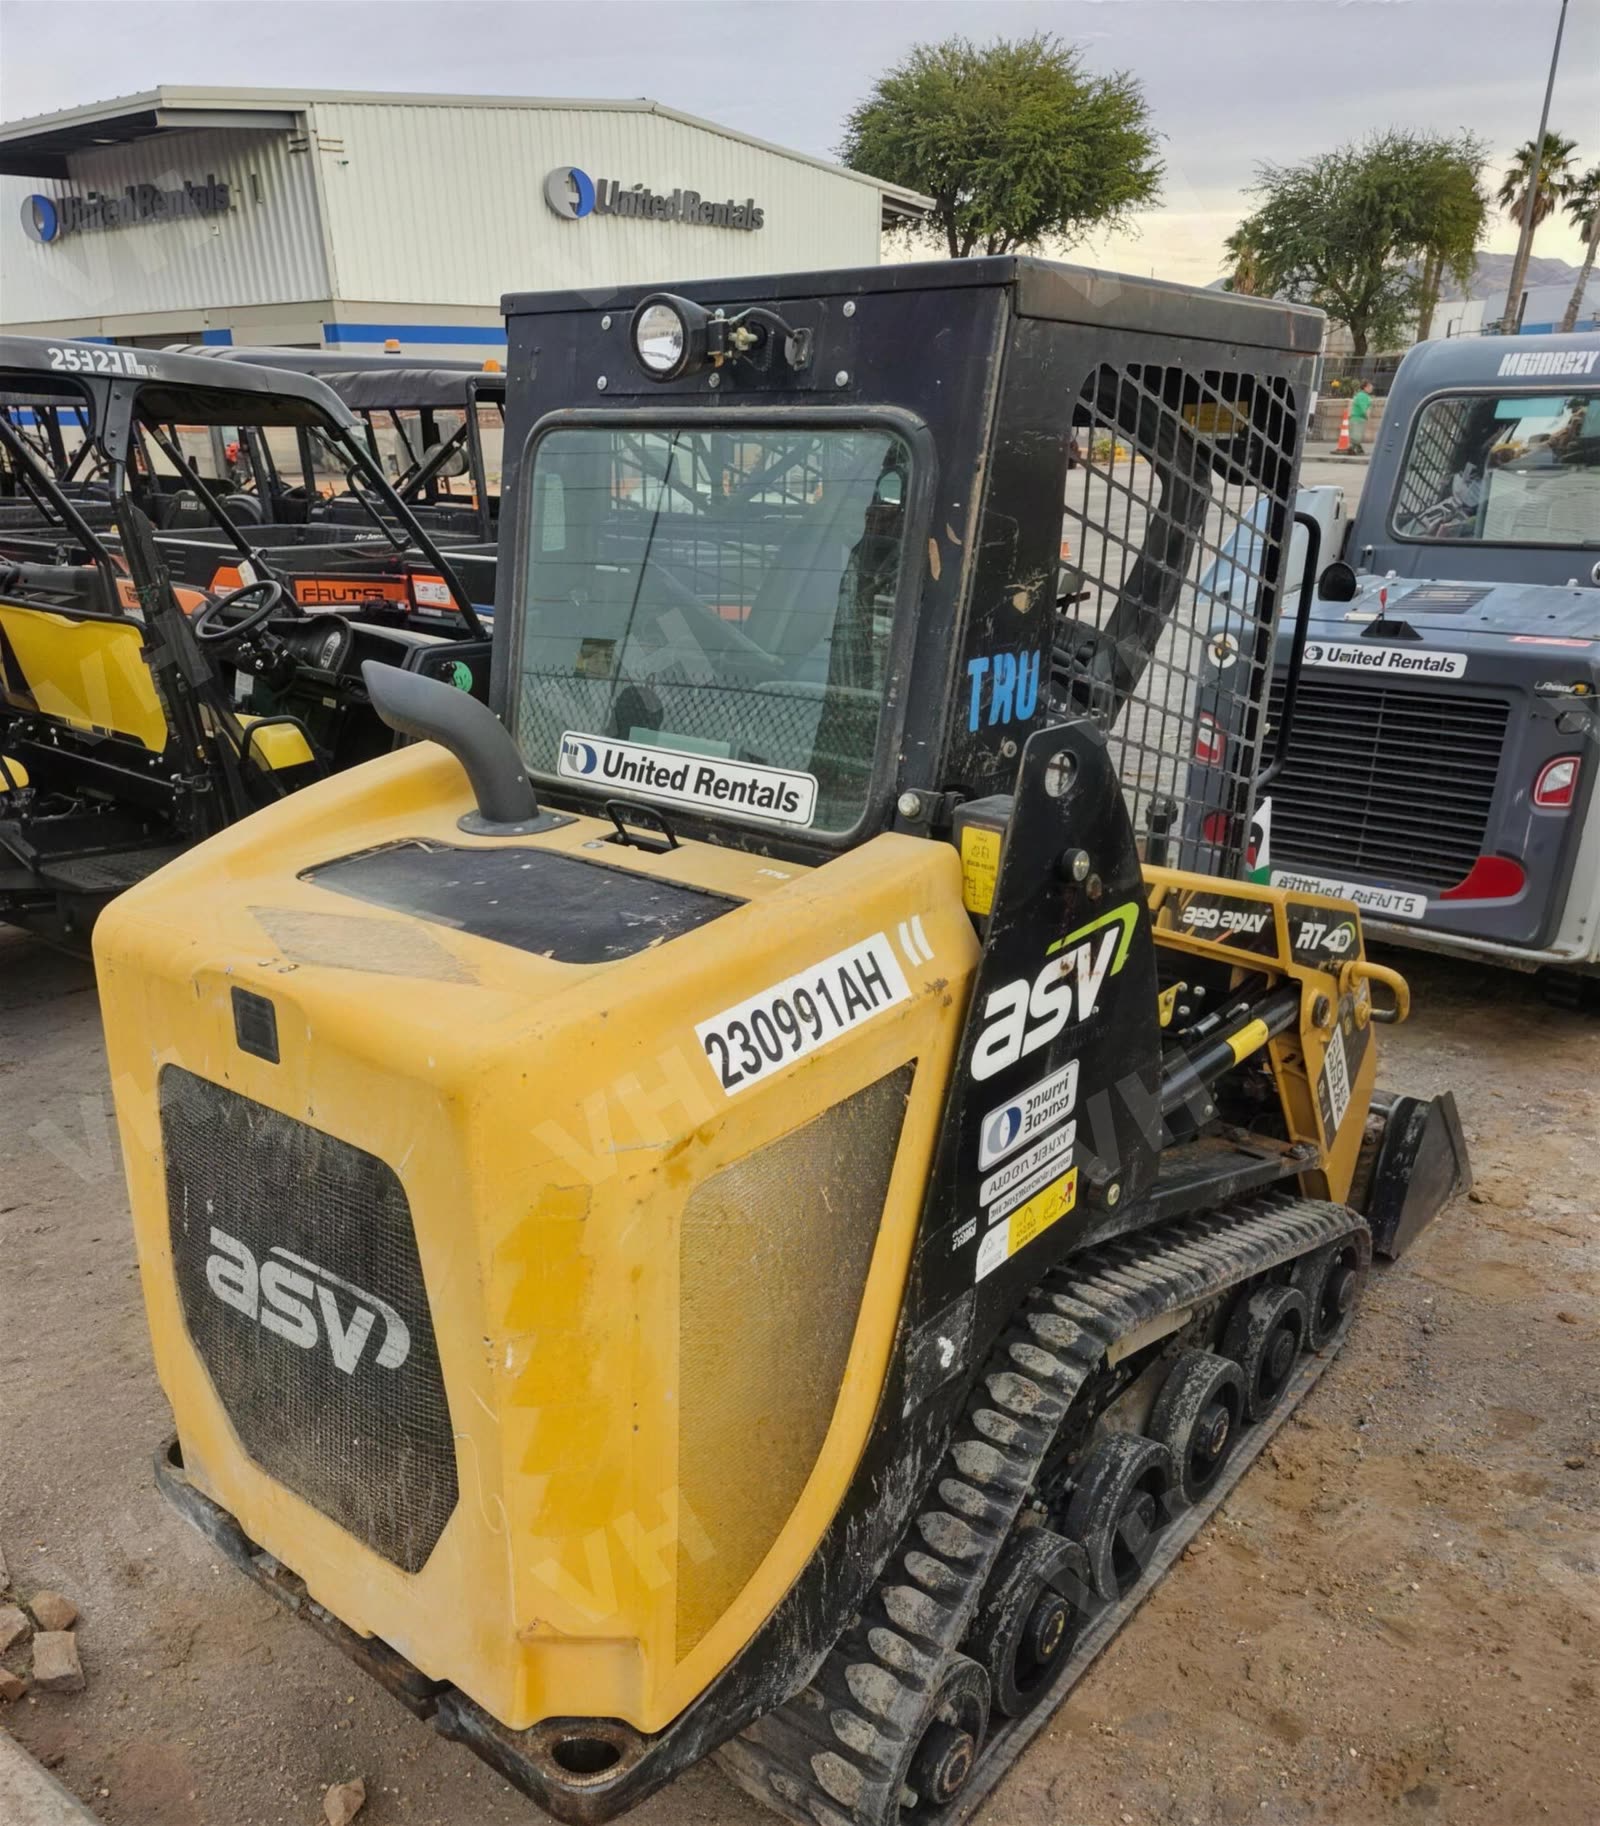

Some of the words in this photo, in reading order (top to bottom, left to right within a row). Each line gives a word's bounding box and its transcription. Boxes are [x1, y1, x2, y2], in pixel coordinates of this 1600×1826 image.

[595, 178, 681, 221] United
[682, 190, 764, 230] Rentals
[1326, 646, 1387, 667] United
[1388, 653, 1456, 673] Rentals
[602, 749, 690, 792] United
[693, 766, 800, 813] Rentals
[704, 950, 893, 1090] 230991AH
